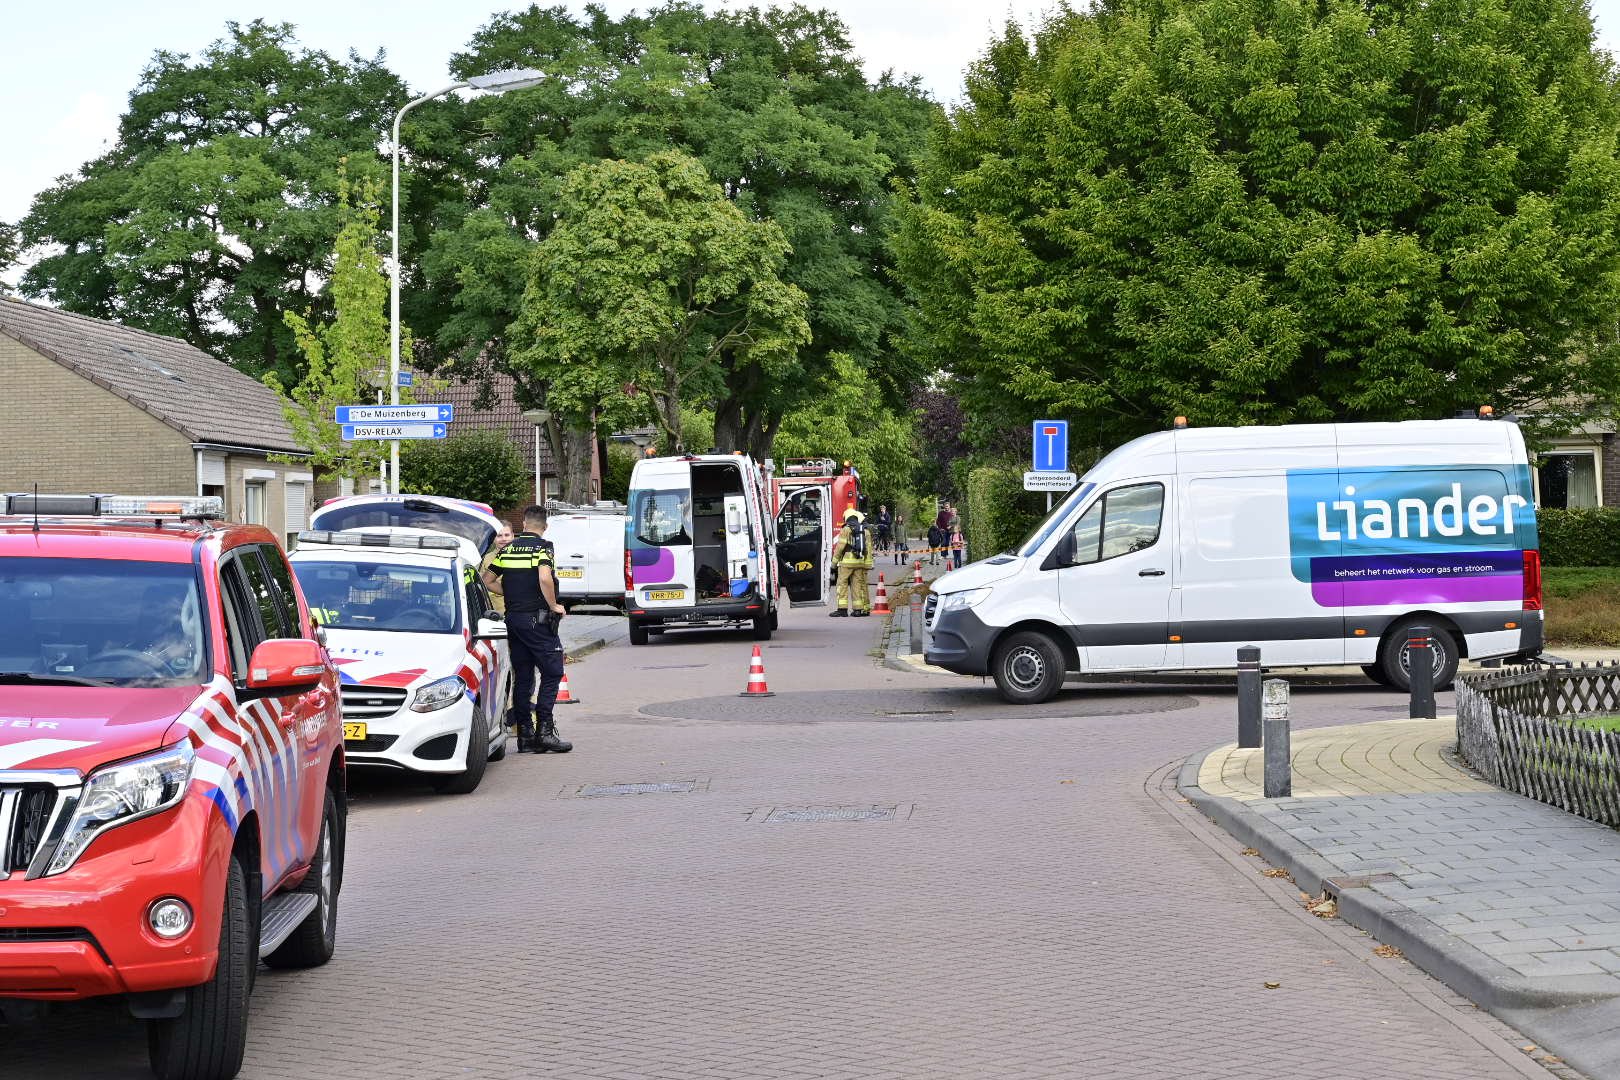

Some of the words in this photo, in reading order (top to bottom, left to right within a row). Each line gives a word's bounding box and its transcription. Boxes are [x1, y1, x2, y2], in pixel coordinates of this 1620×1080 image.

[360, 410, 372, 418] De
[374, 410, 426, 419] Muizenberg
[355, 427, 403, 436] DSV-RELAX
[1316, 482, 1528, 541] Liander
[1334, 569, 1366, 577] beheert
[1367, 568, 1381, 576] het
[1382, 567, 1415, 575] netwerk
[1436, 566, 1451, 575] gas
[1464, 564, 1495, 572] stroom.
